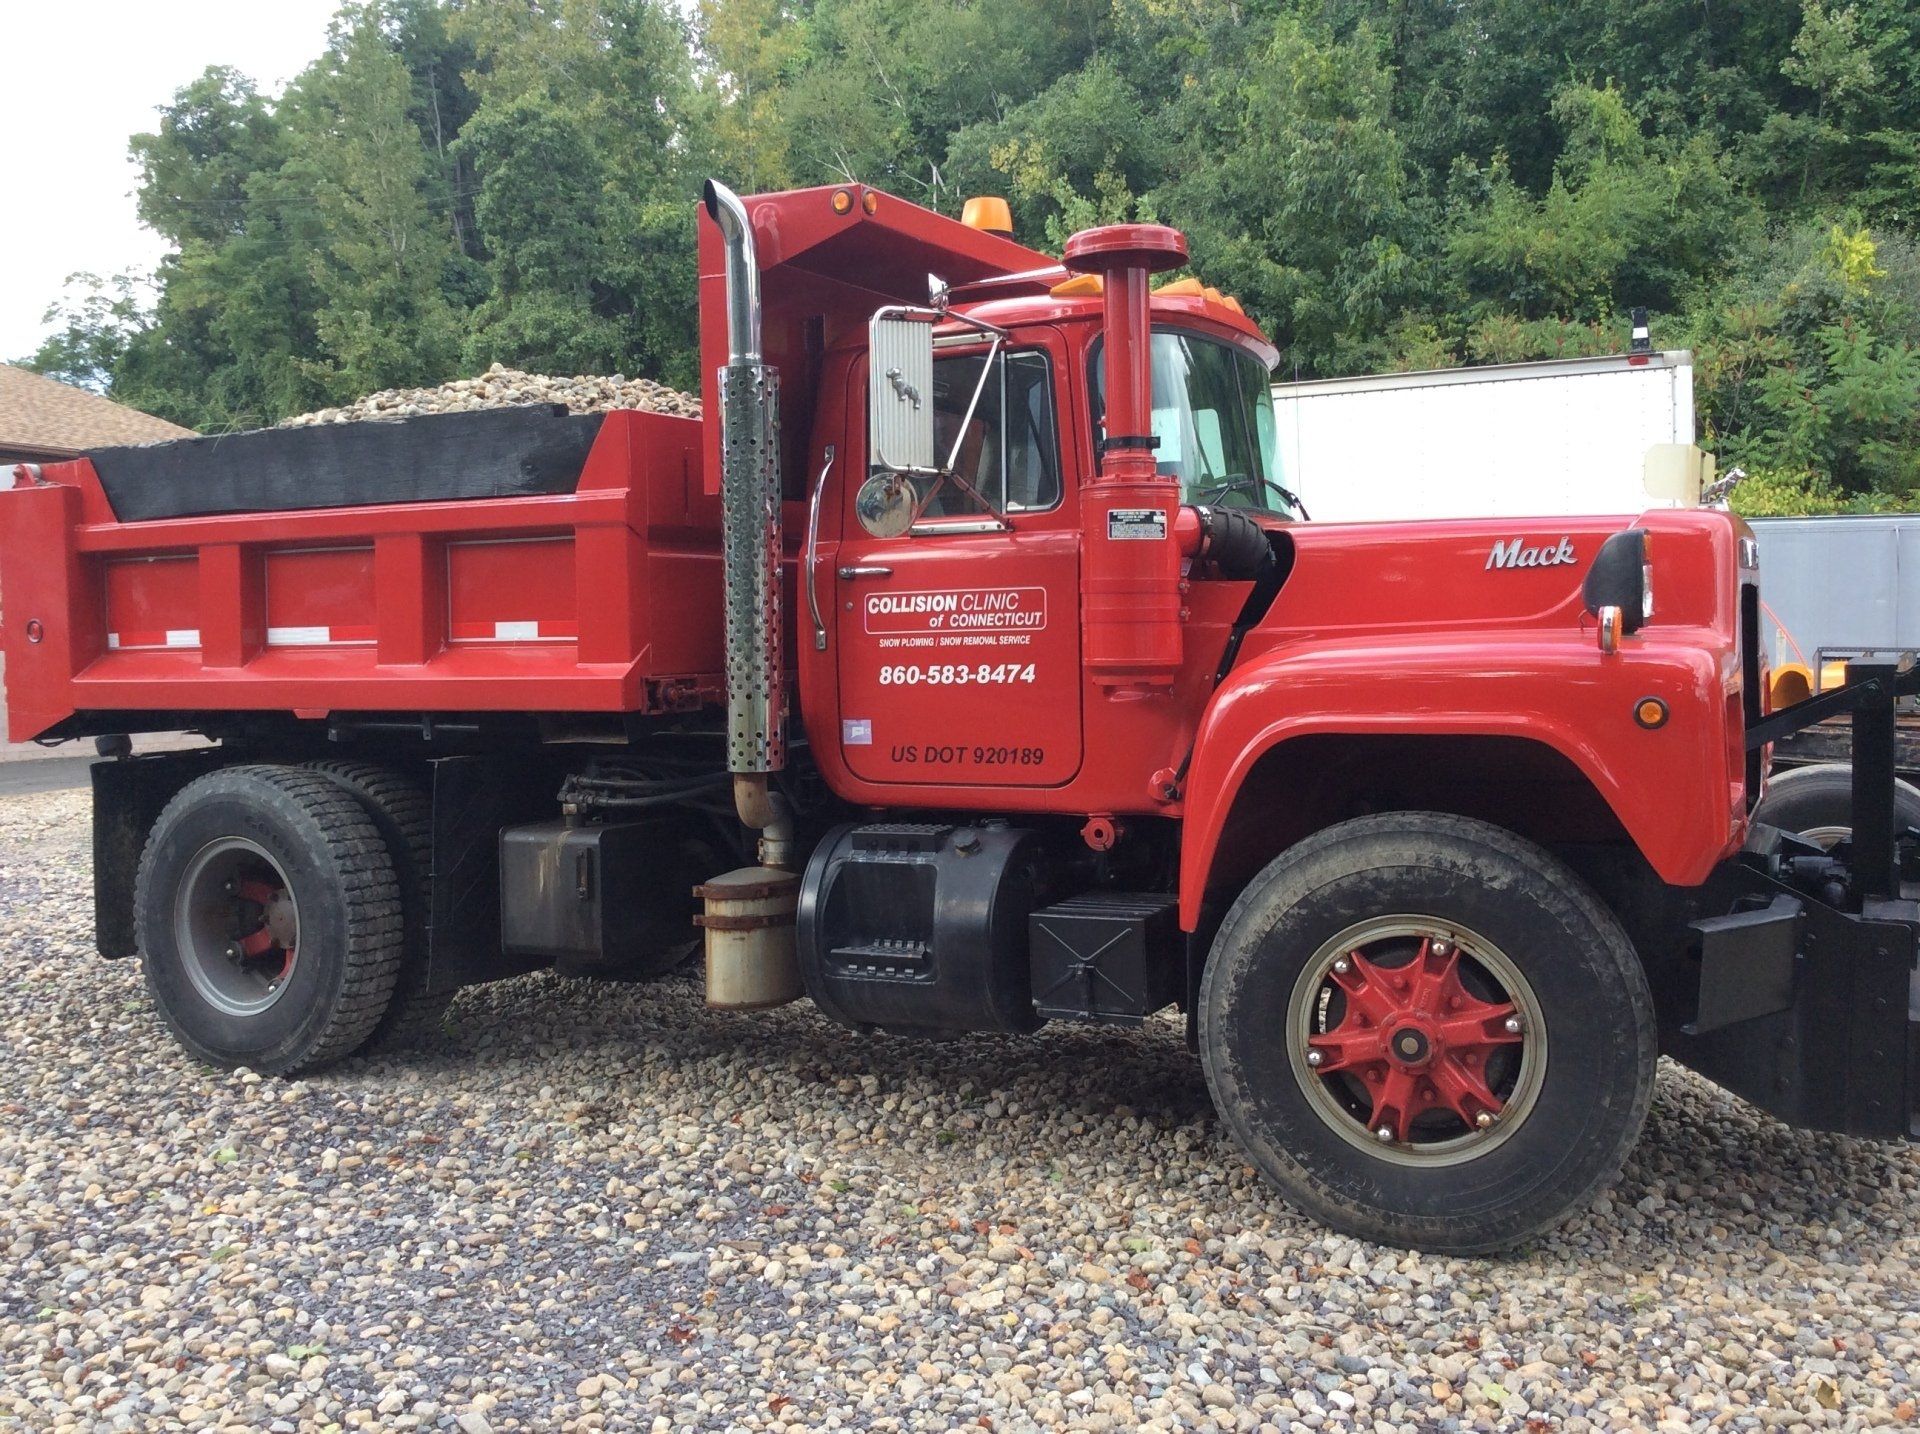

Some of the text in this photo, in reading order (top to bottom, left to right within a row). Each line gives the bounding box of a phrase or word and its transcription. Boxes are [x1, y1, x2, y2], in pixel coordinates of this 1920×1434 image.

[1485, 536, 1578, 570] Mack
[868, 592, 1019, 614] COLLISION CLINIC
[929, 611, 1042, 628] of CONNECTICUT
[879, 638, 899, 648] SNOW
[901, 637, 934, 647] PLOWING
[940, 636, 961, 646] SNOW
[963, 635, 997, 645] REMOVAL
[999, 634, 1030, 645] SERVICE
[878, 663, 1036, 685] 860-583-8474
[891, 745, 1044, 765] US DOT 920189
